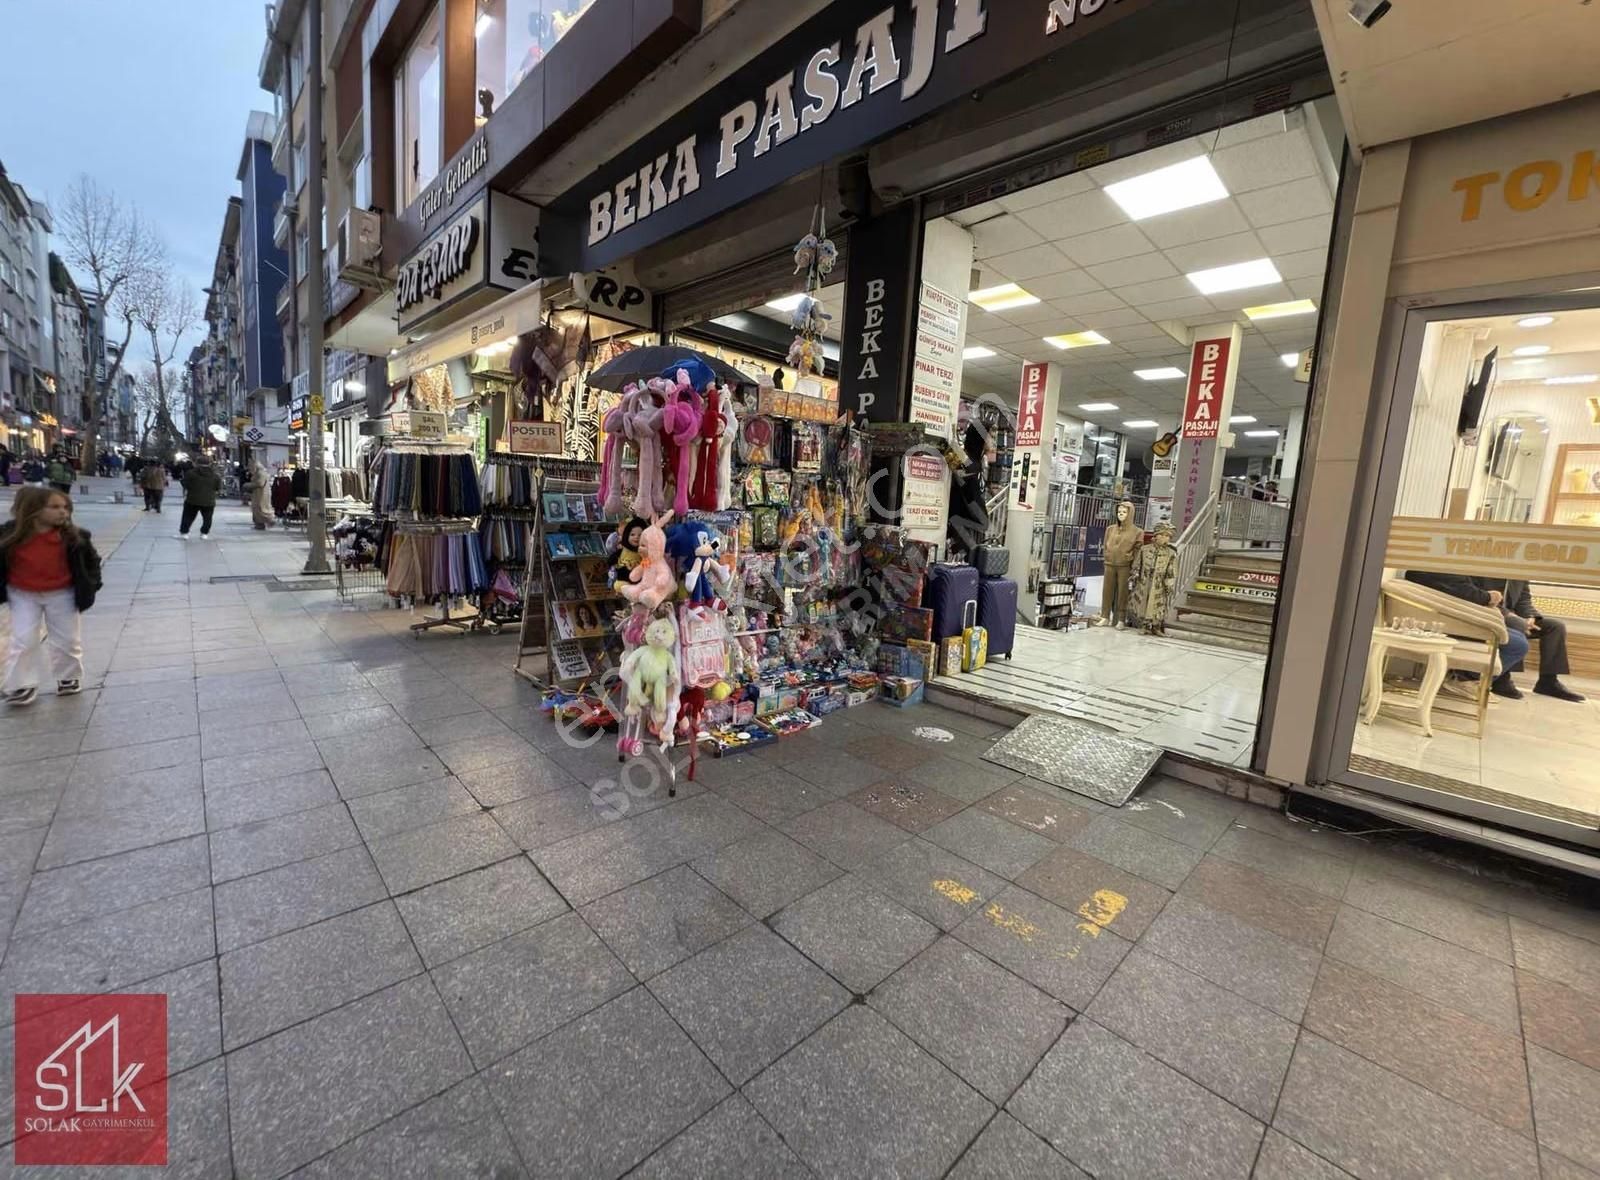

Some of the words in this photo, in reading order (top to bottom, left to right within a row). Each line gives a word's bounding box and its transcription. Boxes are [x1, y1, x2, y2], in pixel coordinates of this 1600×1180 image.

[588, 134, 702, 247] BEKA
[857, 279, 885, 380] BEKA
[915, 360, 935, 377] PINAR
[1023, 367, 1041, 431] BEKA
[1193, 343, 1220, 420] BEKA
[512, 426, 556, 436] POSTER
[1205, 584, 1226, 592] CEP
